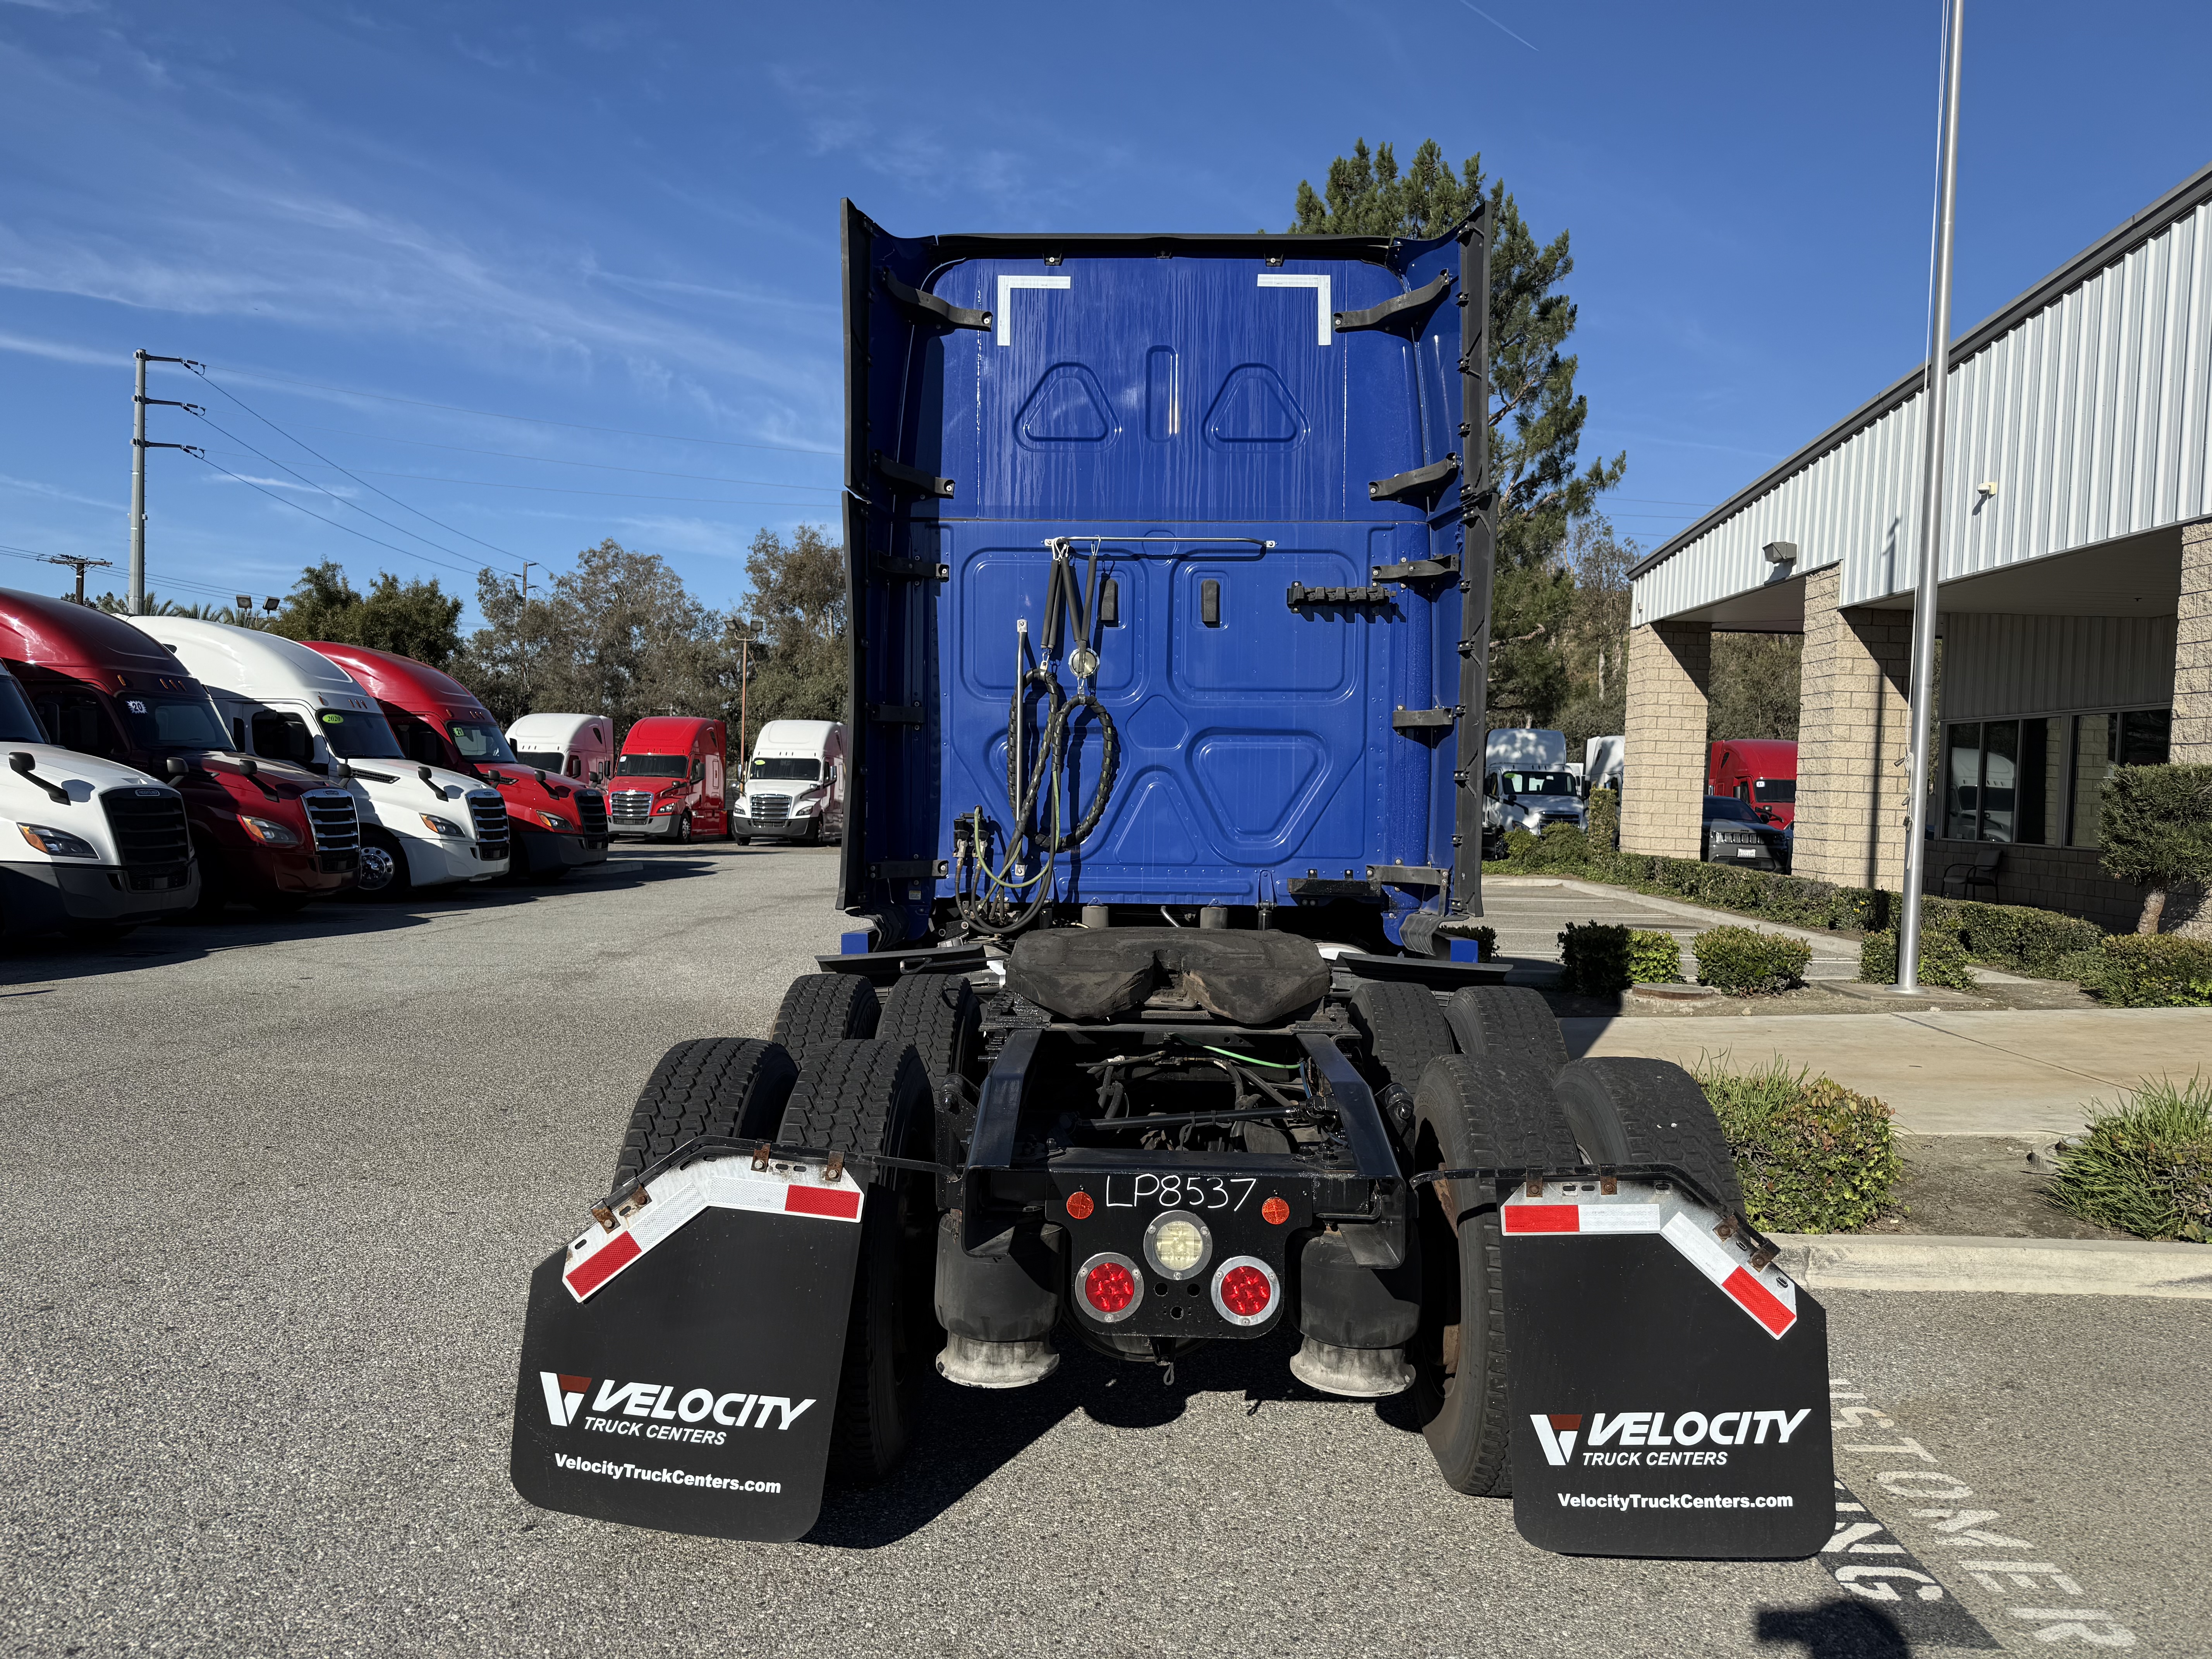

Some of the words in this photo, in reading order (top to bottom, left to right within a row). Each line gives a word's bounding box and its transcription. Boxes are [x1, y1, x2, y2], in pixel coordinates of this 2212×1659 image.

[132, 703, 143, 711] 20
[1106, 1173, 1256, 1212] LP8537
[592, 1379, 817, 1430] VELOCITY
[584, 1416, 644, 1436] TRUCK
[646, 1424, 727, 1445] CENTERS
[1587, 1408, 1812, 1446] VELOCITY
[555, 1453, 781, 1493] VelocityTruckCenters.com
[1583, 1452, 1642, 1466] TRUCK
[1646, 1451, 1728, 1466] CENTERS
[1557, 1493, 1793, 1511] VelocityTruckCenters.com
